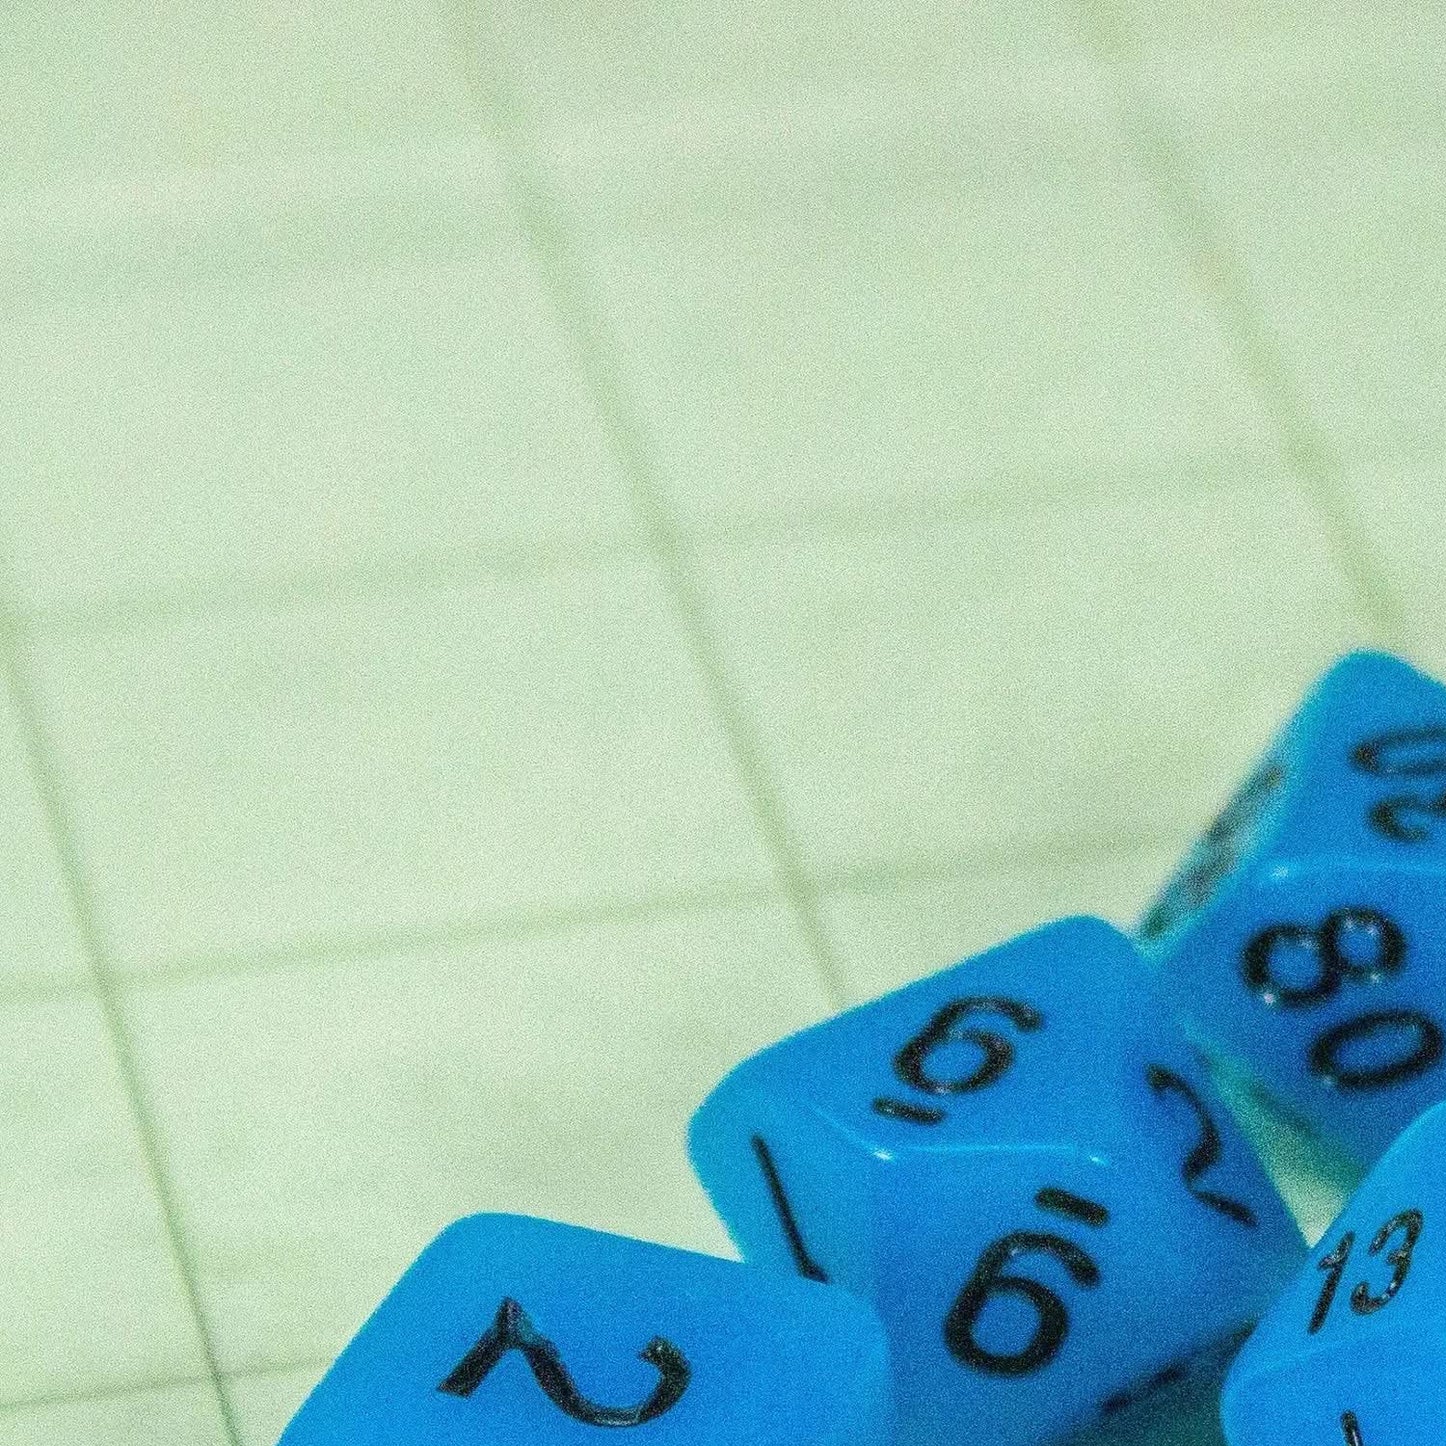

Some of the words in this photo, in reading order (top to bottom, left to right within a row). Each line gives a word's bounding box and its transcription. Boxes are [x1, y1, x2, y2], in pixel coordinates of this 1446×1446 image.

[1242, 909, 1445, 1093] 80
[1146, 1064, 1260, 1230] 2
[1309, 1210, 1422, 1332] 13
[438, 1298, 692, 1428] 2
